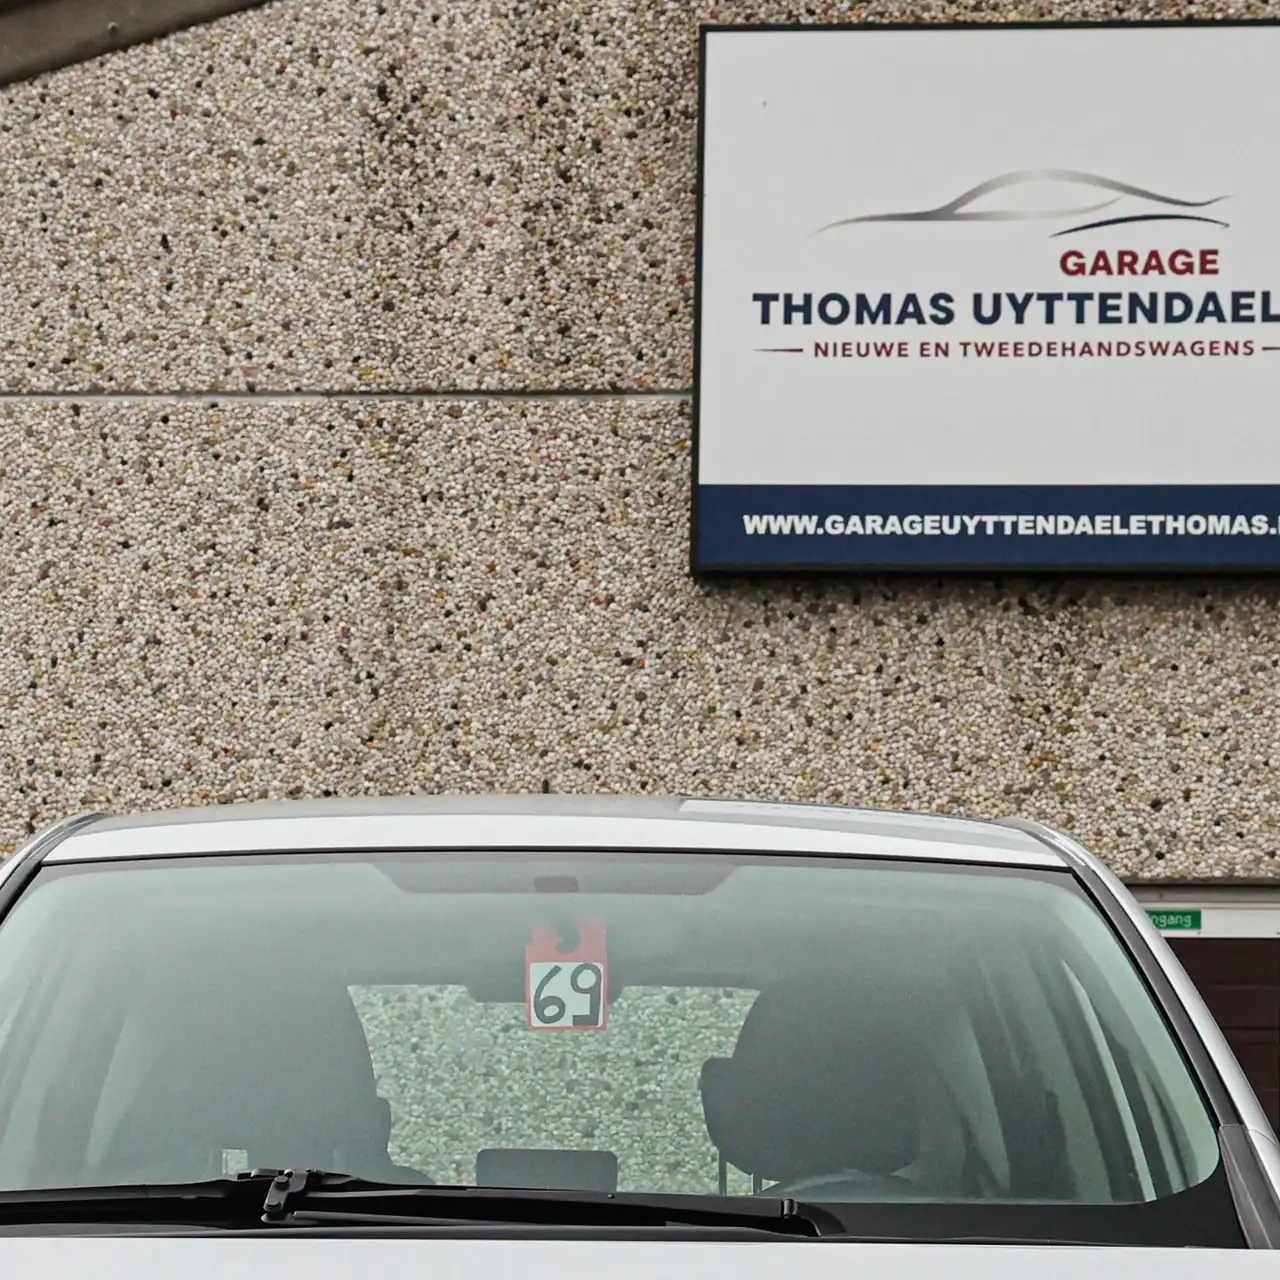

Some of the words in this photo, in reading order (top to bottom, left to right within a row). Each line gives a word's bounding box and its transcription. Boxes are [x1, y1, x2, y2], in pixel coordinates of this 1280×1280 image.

[1059, 248, 1220, 277] GARAGE
[752, 292, 954, 327] THOMAS
[813, 341, 909, 359] NIEUWE
[919, 341, 950, 358] EN
[959, 340, 1255, 358] TWEEDEHANDSWAGENS
[1149, 914, 1192, 928] ngang
[533, 962, 602, 1026] 69
